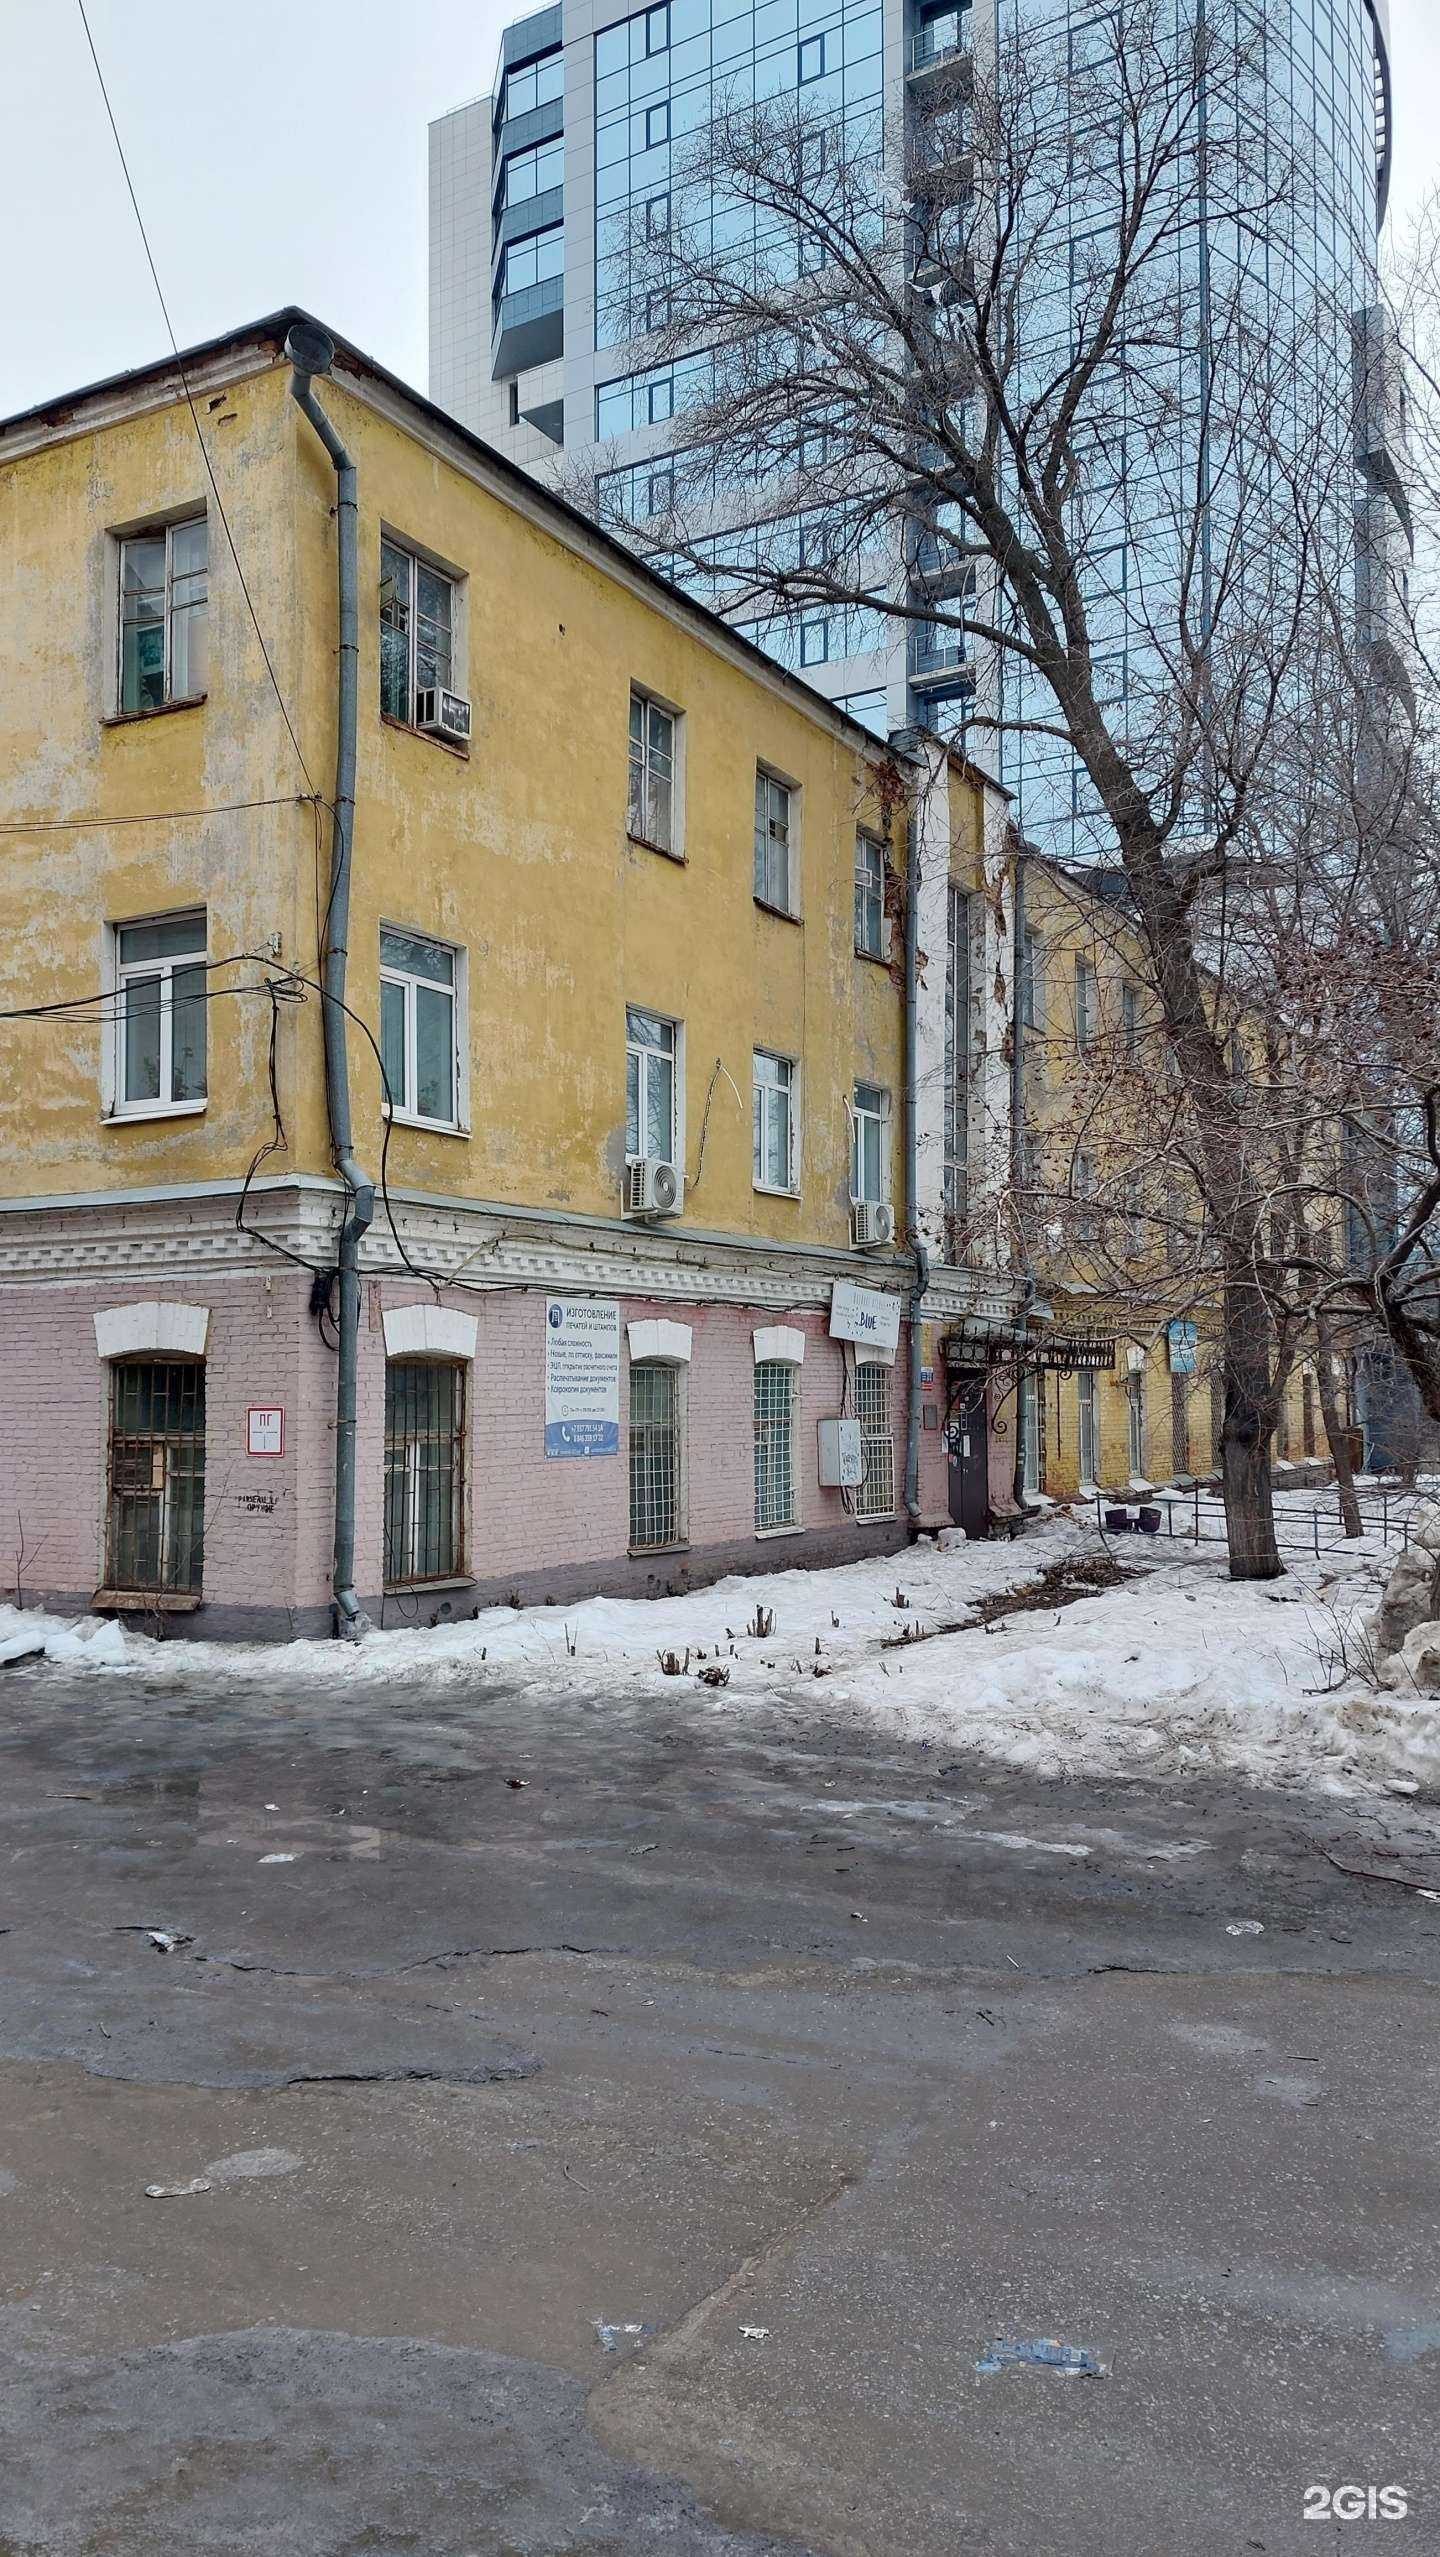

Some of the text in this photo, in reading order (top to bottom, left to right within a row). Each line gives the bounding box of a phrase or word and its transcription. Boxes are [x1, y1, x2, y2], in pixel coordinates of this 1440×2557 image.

[566, 1308, 616, 1320] ИЗГОТОВЛЕНИЕ
[566, 1321, 588, 1331] ПЕЧАТЕЙ
[593, 1323, 617, 1332] ШТАМПОВ
[550, 1337, 567, 1346] Любая
[259, 1413, 273, 1427] ПГ
